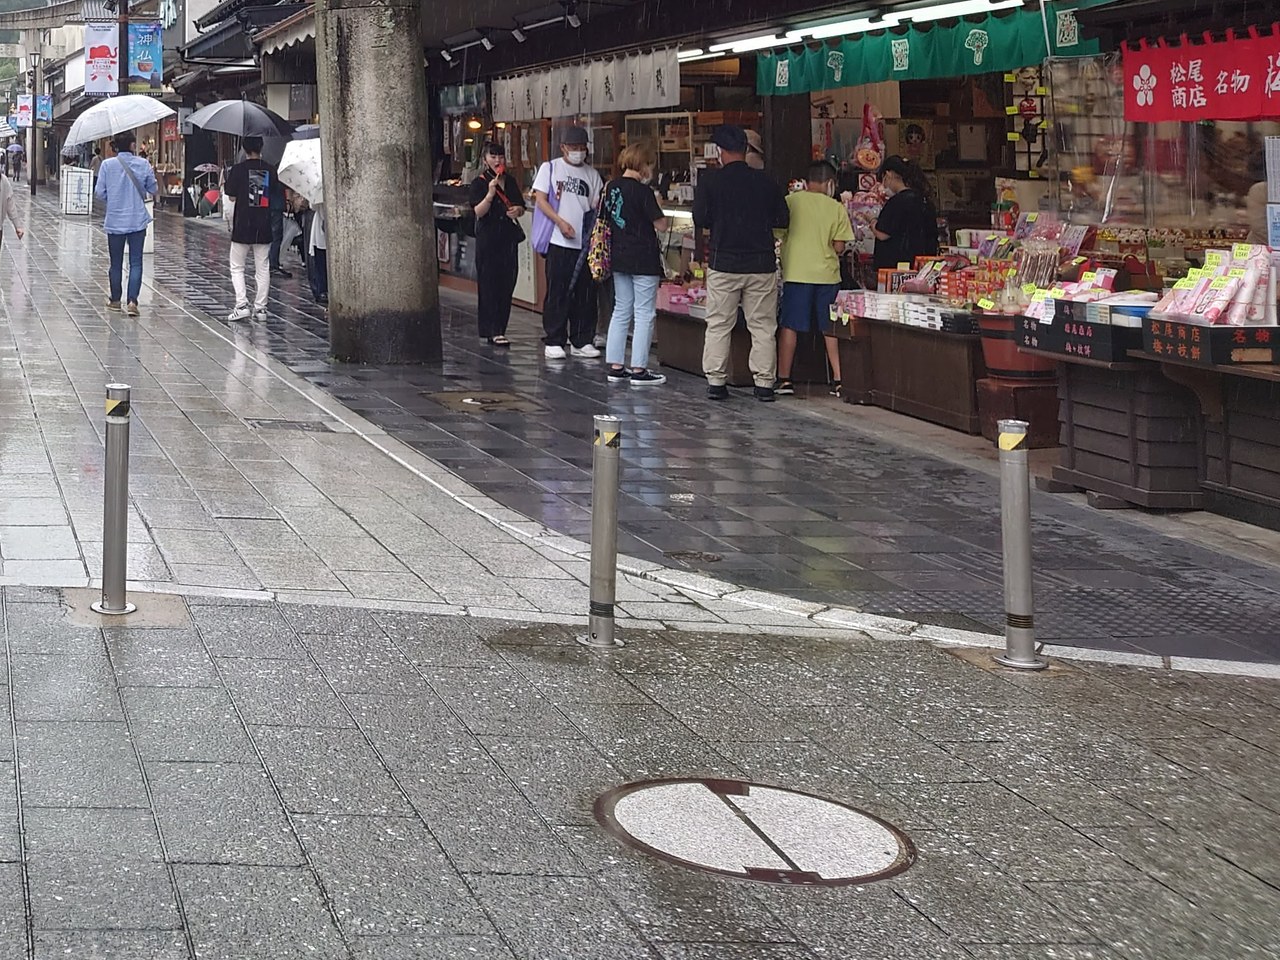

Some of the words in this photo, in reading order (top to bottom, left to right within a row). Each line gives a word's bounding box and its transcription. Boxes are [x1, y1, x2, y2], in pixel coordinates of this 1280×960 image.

[1170, 59, 1205, 84] 松尾
[1214, 69, 1251, 94] 名物
[1171, 85, 1207, 108] 商店
[1024, 335, 1038, 347] 名物
[1151, 321, 1201, 342] 松尾商店
[1233, 330, 1271, 343] 名物
